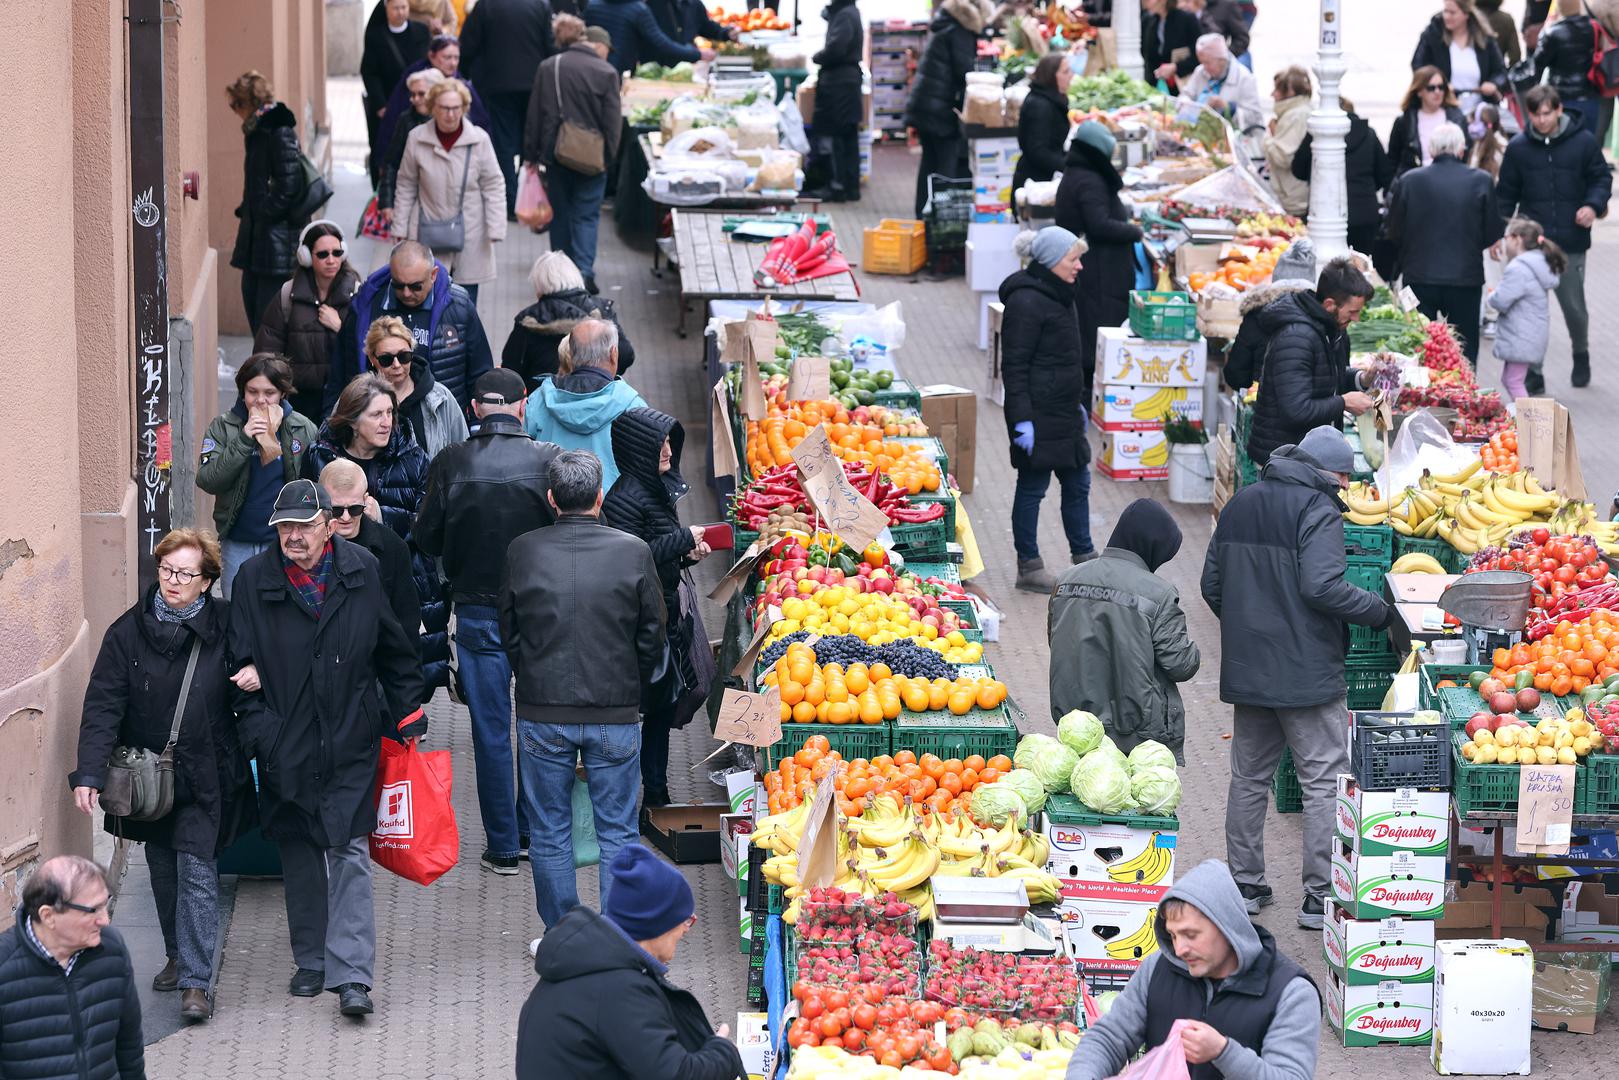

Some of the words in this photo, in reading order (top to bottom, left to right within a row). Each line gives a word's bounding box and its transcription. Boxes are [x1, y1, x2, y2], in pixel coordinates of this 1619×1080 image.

[1142, 371, 1169, 383] KING
[1057, 831, 1082, 844] Dole
[1372, 824, 1437, 842] Doğanbey
[1370, 887, 1434, 906] Doğanbey
[1062, 911, 1079, 921] ole
[1359, 953, 1423, 971] Doğanbey
[1356, 1015, 1421, 1033] Doğanbey
[762, 1050, 771, 1073] Extra
